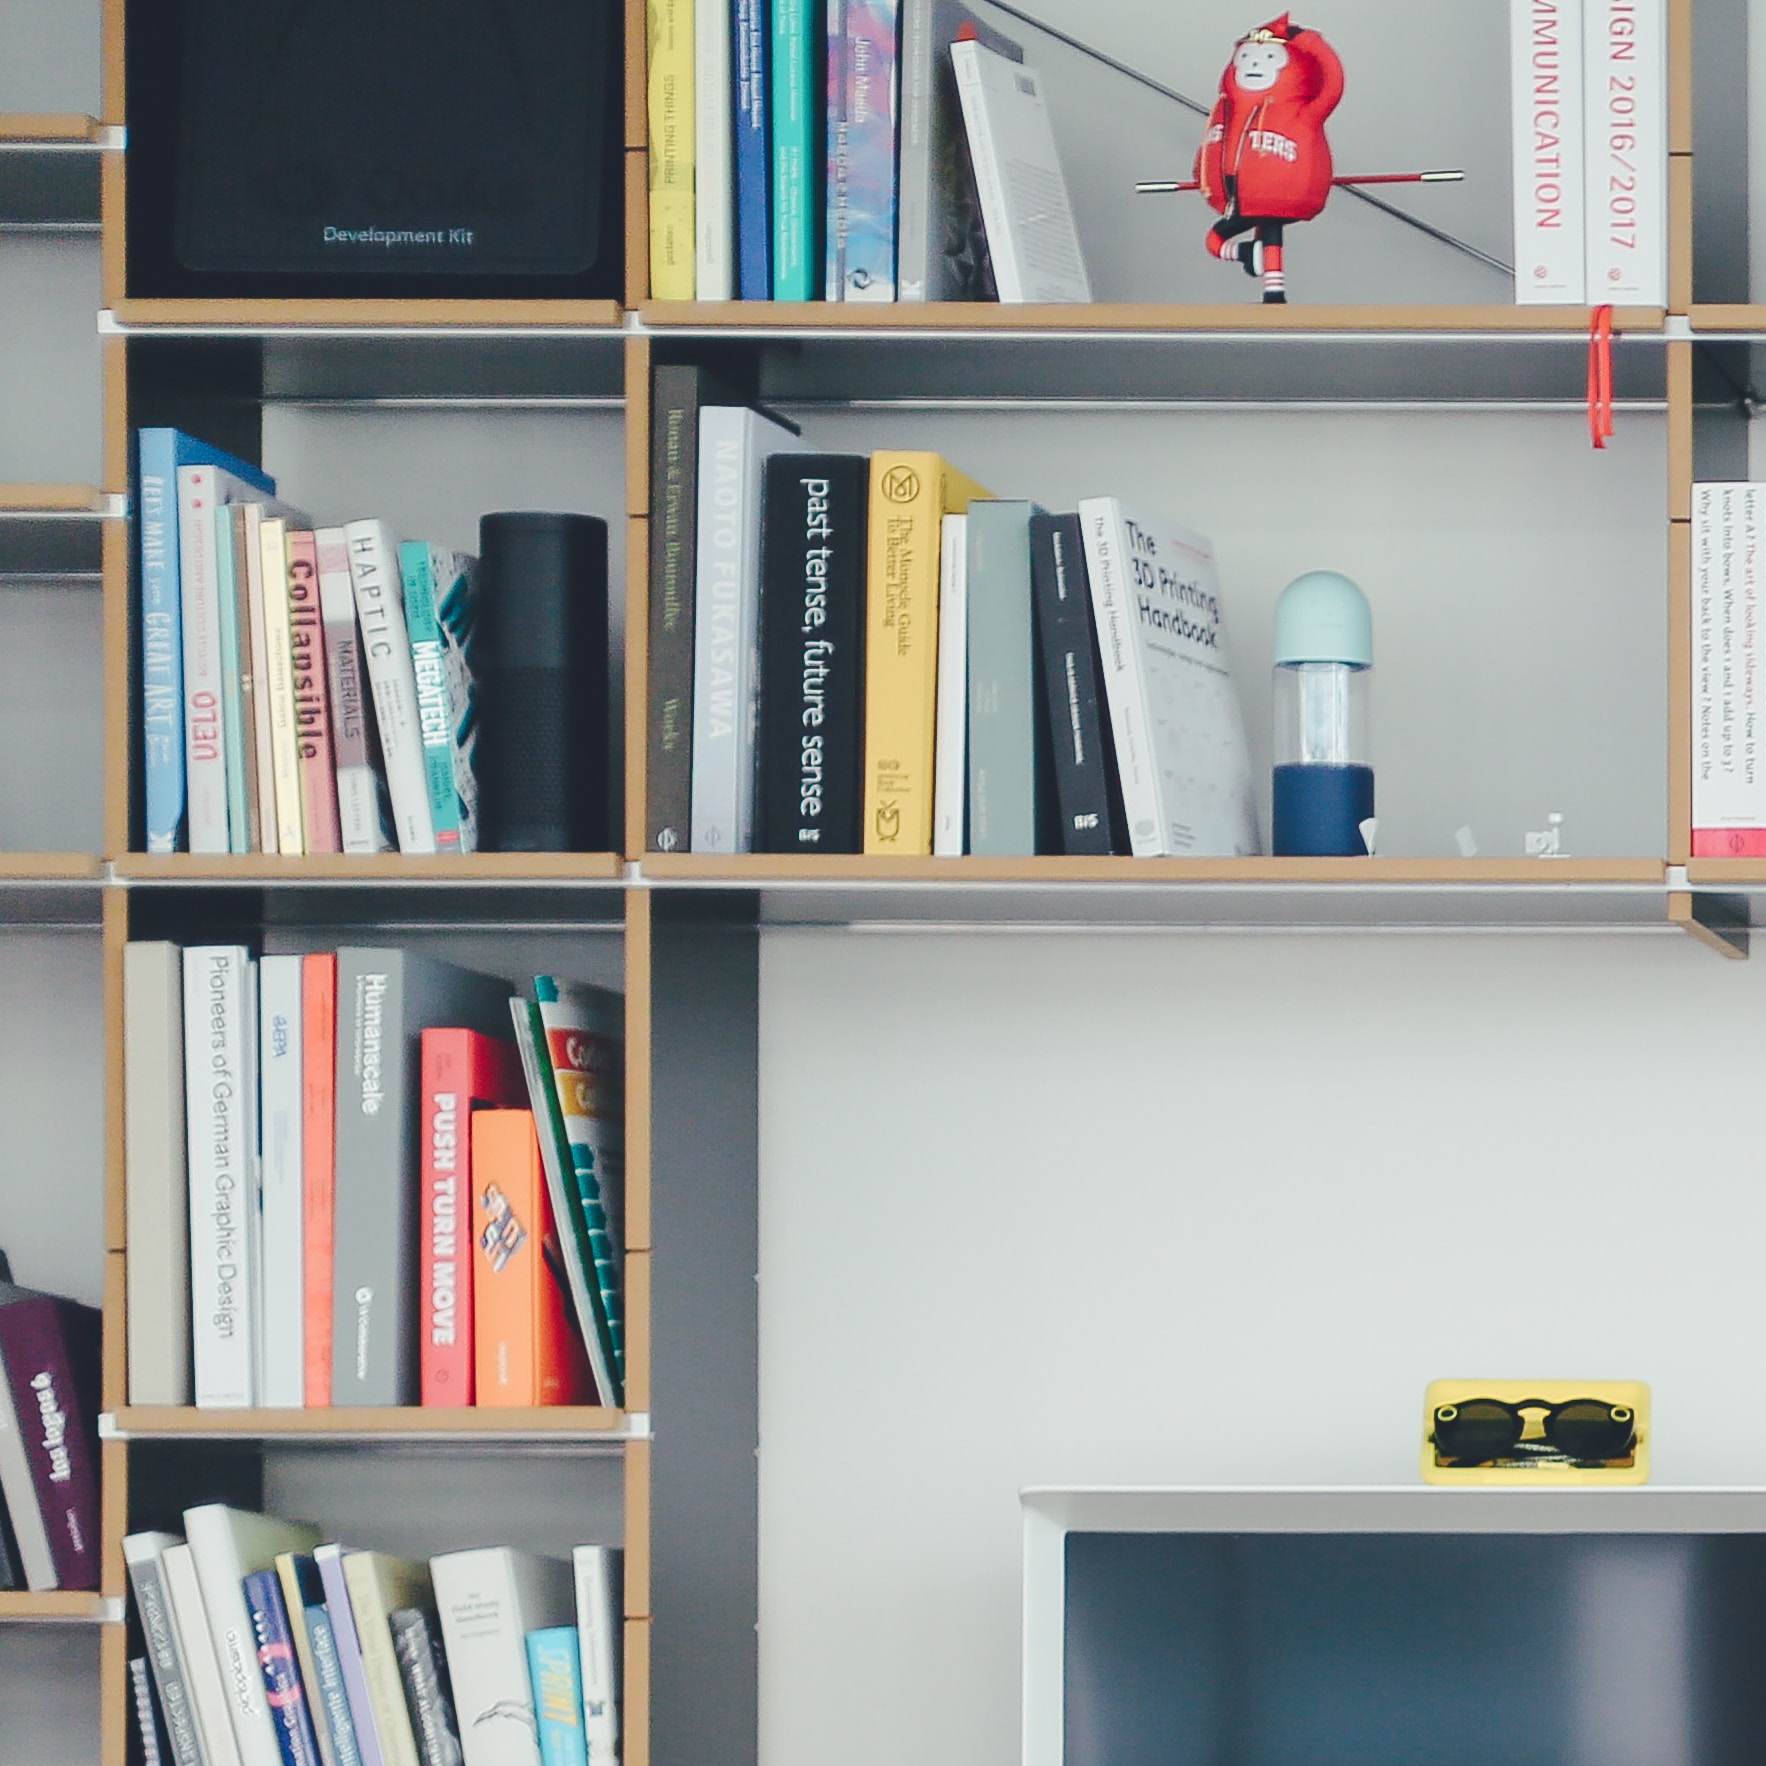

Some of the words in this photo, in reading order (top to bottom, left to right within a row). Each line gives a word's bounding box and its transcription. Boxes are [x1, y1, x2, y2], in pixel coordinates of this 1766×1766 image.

[853, 36, 870, 72] John
[854, 76, 870, 124] Maeda
[323, 225, 444, 247] Development
[450, 225, 475, 245] Kit
[801, 478, 834, 540] past
[885, 516, 899, 531] To
[897, 515, 913, 543] The
[801, 545, 834, 633] tense,
[884, 534, 899, 581] Better
[897, 549, 913, 611] Monocle
[351, 536, 391, 659] HAPTIC
[882, 584, 899, 627] Living
[896, 613, 912, 656] Guide
[411, 640, 451, 747] MEGATECH
[803, 640, 834, 725] future
[801, 734, 824, 815] sense
[209, 955, 235, 1049] Pioneers
[212, 1054, 233, 1077] of
[361, 974, 387, 1115] Humanscale
[211, 1081, 234, 1169] German
[432, 1093, 457, 1170] PUSH
[209, 1174, 237, 1259] Graphic
[432, 1177, 457, 1256] TURN
[213, 1263, 239, 1339] Design
[432, 1262, 456, 1347] MOVE
